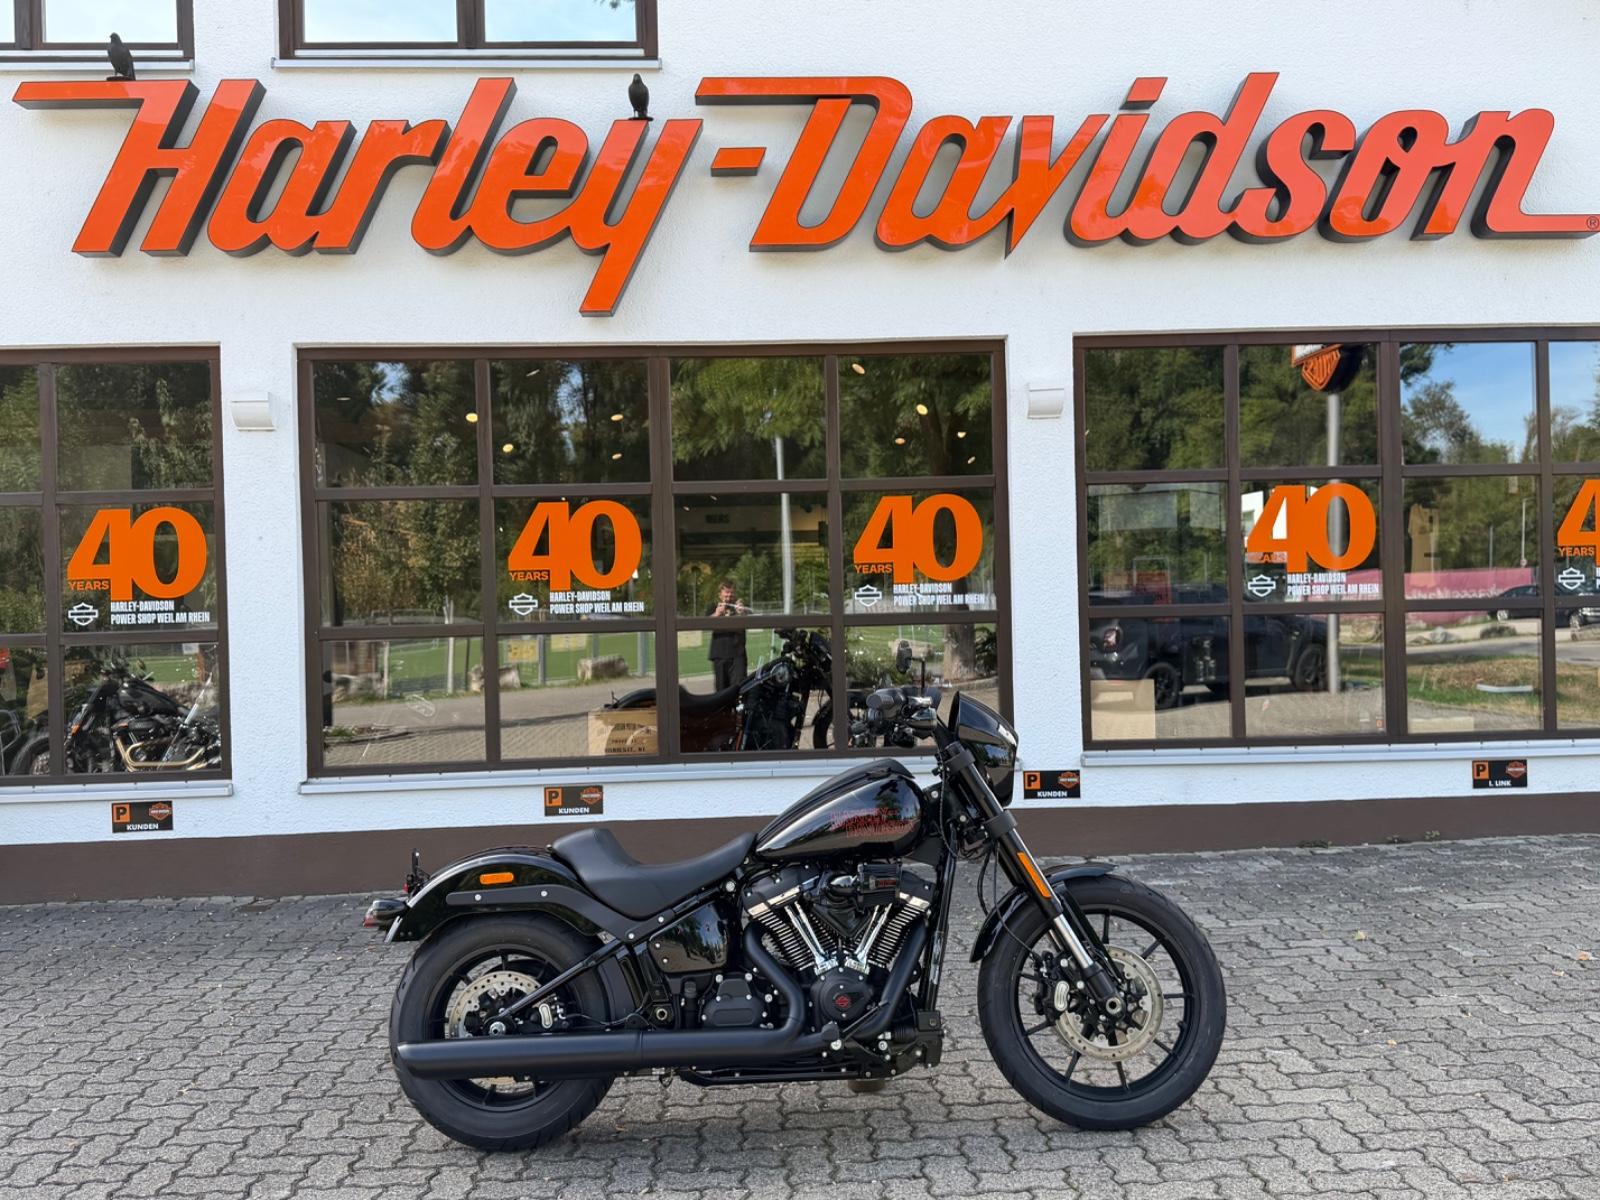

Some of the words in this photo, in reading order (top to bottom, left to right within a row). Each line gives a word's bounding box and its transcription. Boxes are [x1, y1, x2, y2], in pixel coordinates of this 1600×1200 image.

[1247, 482, 1376, 573] 40
[1557, 479, 1600, 568] 4
[507, 499, 642, 590] 40
[853, 493, 983, 583] 40
[67, 506, 208, 600] 40
[1558, 547, 1594, 557] YEARS
[854, 564, 892, 574] YEARS
[509, 571, 548, 581] YEARS
[68, 580, 110, 591] YEARS
[549, 590, 611, 602] HARLEY-DAVIDSON
[110, 600, 175, 612] HARLEY-DAVIDSON
[549, 603, 574, 614] POWER
[575, 603, 593, 614] SHOP
[594, 602, 612, 613] WEIL
[611, 602, 622, 612] AM
[623, 601, 645, 612] RHEIN
[110, 614, 136, 625] POWER
[137, 613, 156, 624] SHOP
[157, 612, 175, 623] WEIL
[175, 612, 187, 623] AM
[188, 611, 210, 623] RHEIN
[1476, 764, 1486, 777] P
[1027, 774, 1038, 788] P
[548, 791, 560, 804] P
[116, 807, 127, 820] P
[558, 807, 590, 815] KUNDEN
[126, 823, 159, 831] KUNDEN
